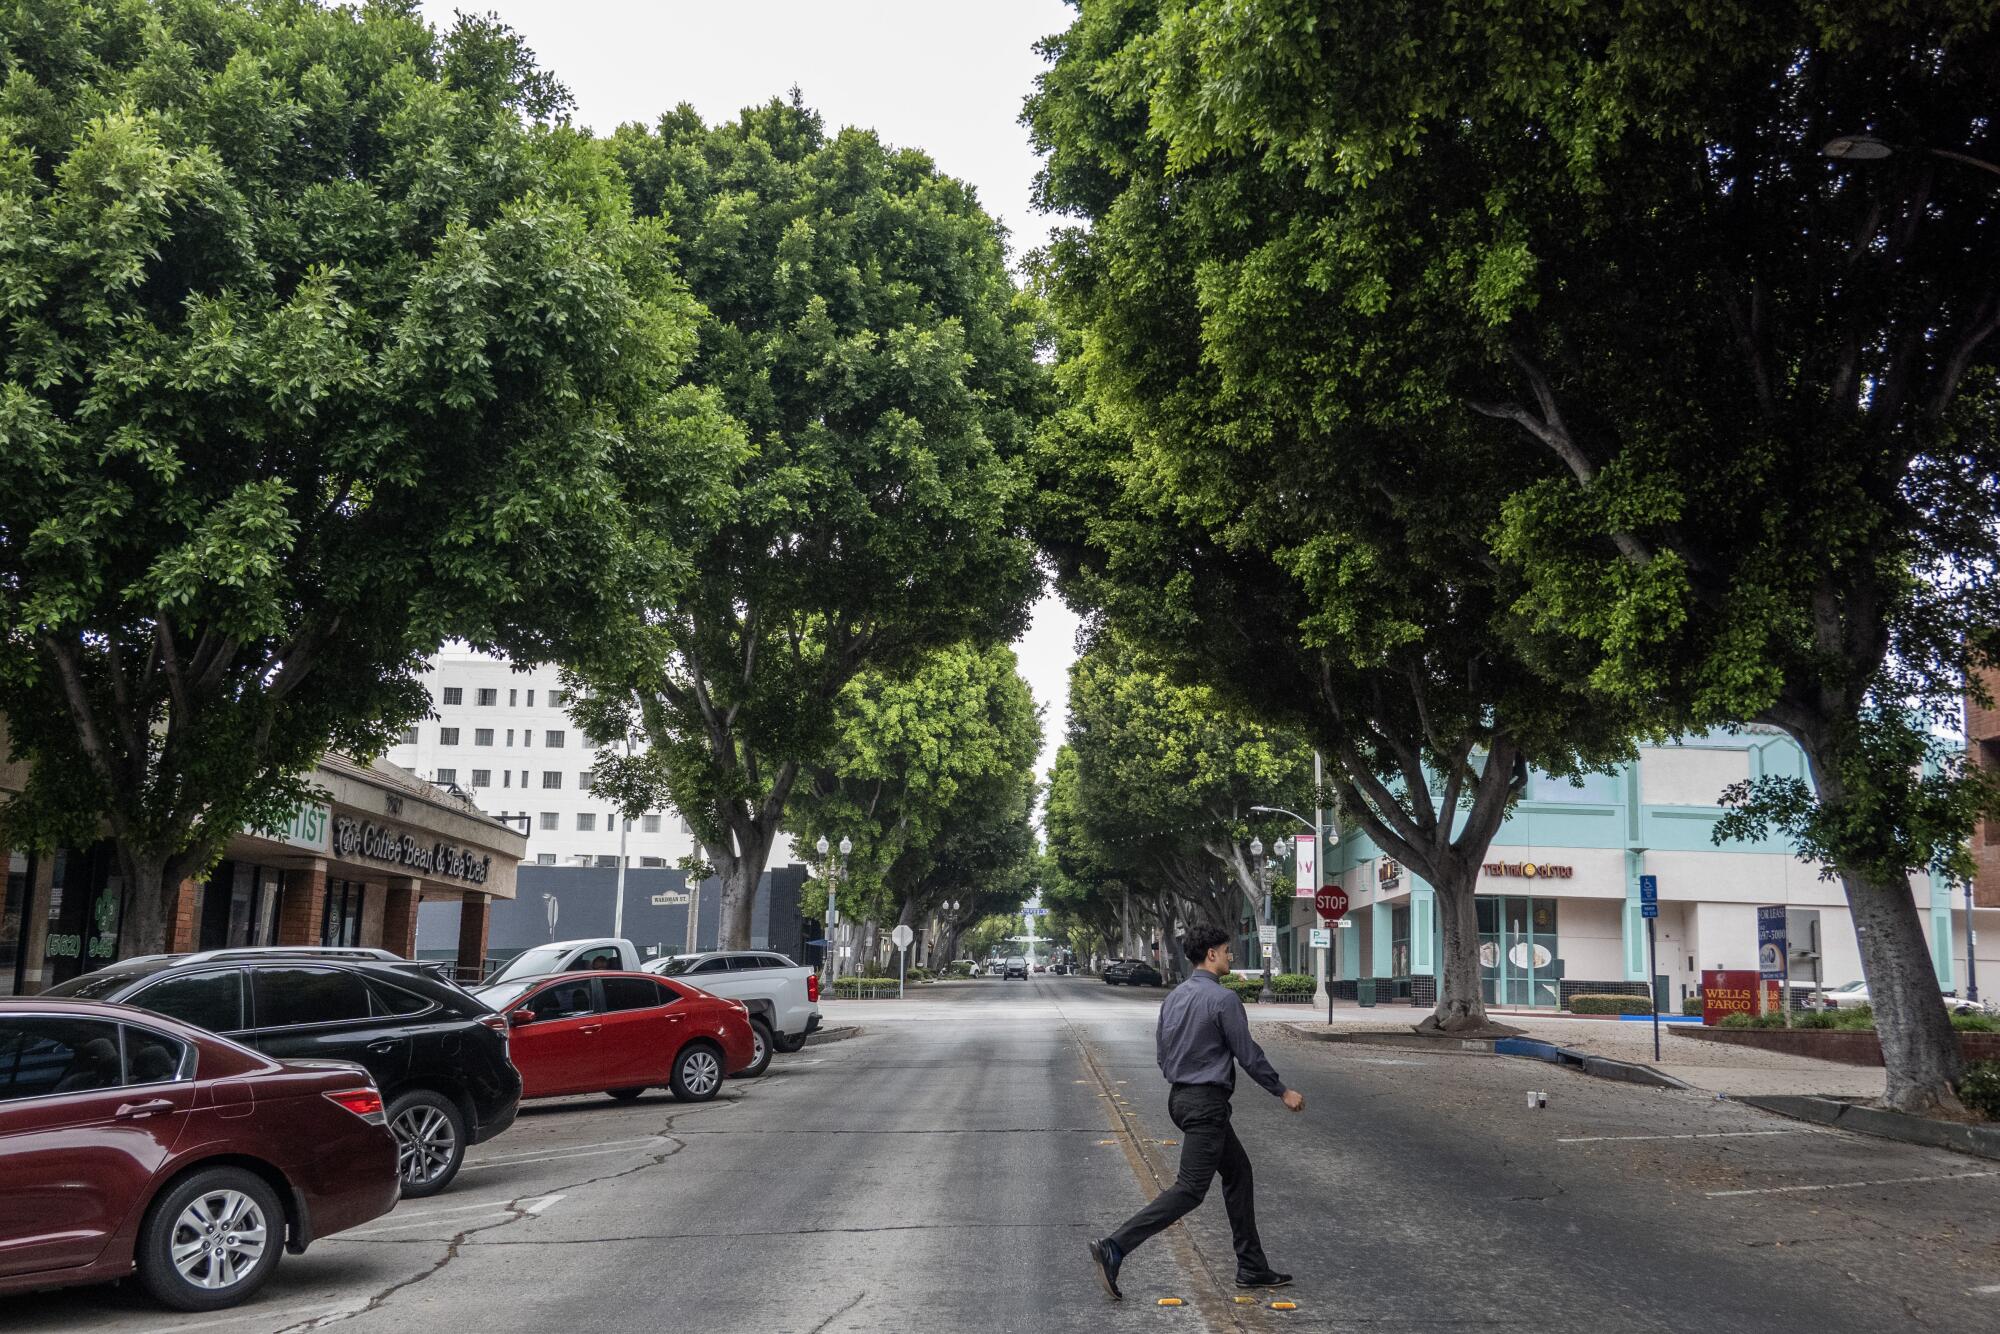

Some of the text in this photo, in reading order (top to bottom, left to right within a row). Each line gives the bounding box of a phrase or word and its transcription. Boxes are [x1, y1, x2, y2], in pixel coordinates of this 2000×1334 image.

[338, 818, 361, 855] The
[363, 823, 401, 861] Coffee
[403, 835, 434, 874] Bean
[436, 843, 445, 871] &
[448, 848, 465, 877] Tea
[1317, 896, 1346, 910] STOP
[46, 933, 80, 958] (562)
[1705, 989, 1750, 999] WELLS
[1706, 1000, 1750, 1010] FARGO
